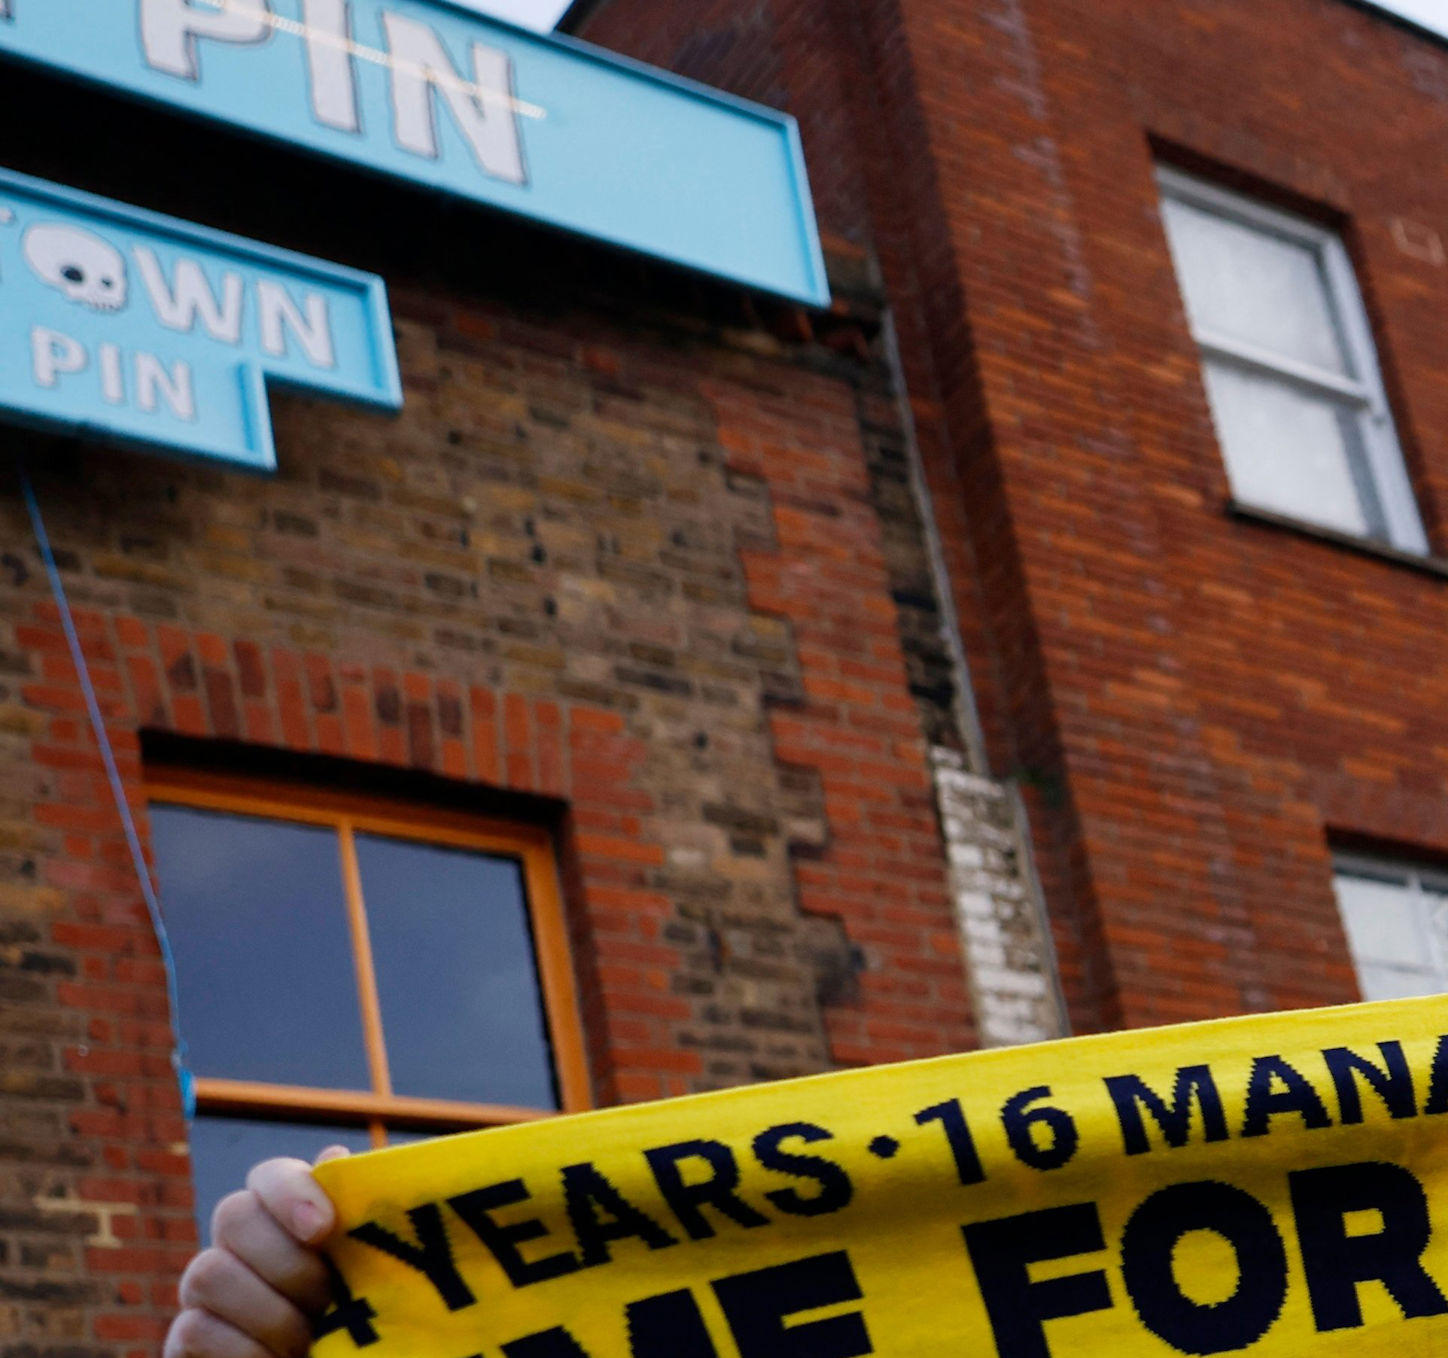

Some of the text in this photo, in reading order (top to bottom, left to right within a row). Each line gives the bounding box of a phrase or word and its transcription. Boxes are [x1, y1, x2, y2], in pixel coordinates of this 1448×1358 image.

[31, 326, 194, 420] PIN
[347, 1121, 854, 1311] YEARS
[914, 1084, 1081, 1187] 16
